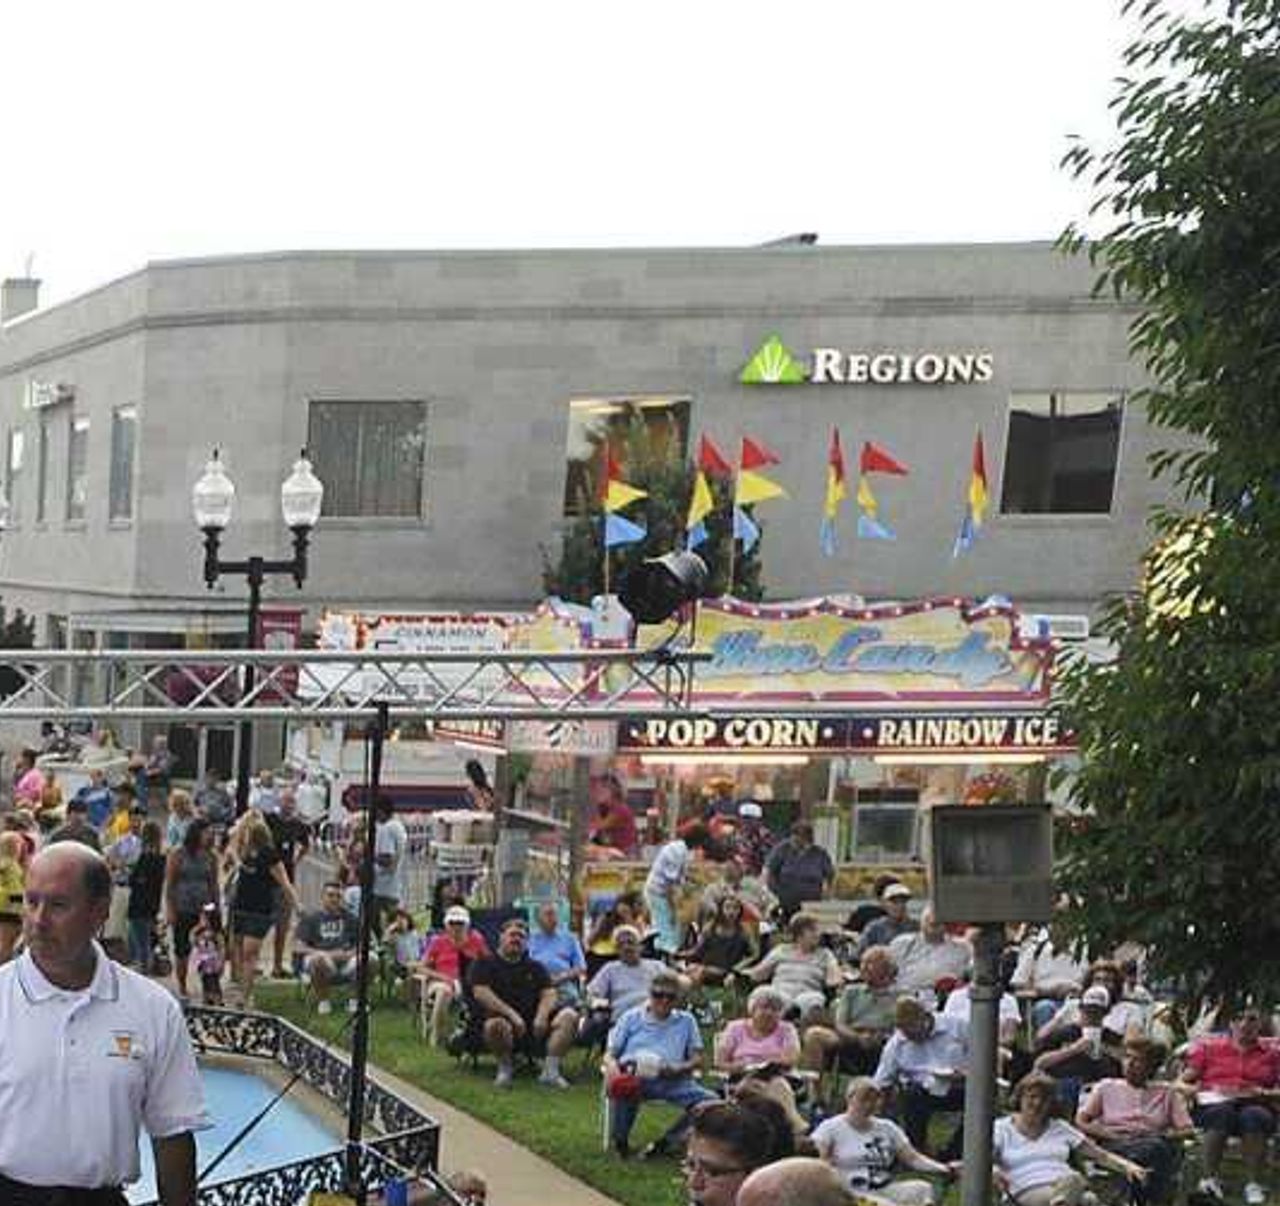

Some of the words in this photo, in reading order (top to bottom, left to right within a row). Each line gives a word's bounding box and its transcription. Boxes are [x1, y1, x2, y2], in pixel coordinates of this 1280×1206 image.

[812, 348, 994, 382] REGIONS
[647, 720, 717, 746] POP
[723, 720, 818, 746] CORN
[878, 720, 1007, 746] RAINBOW
[1013, 718, 1058, 744] ICE
